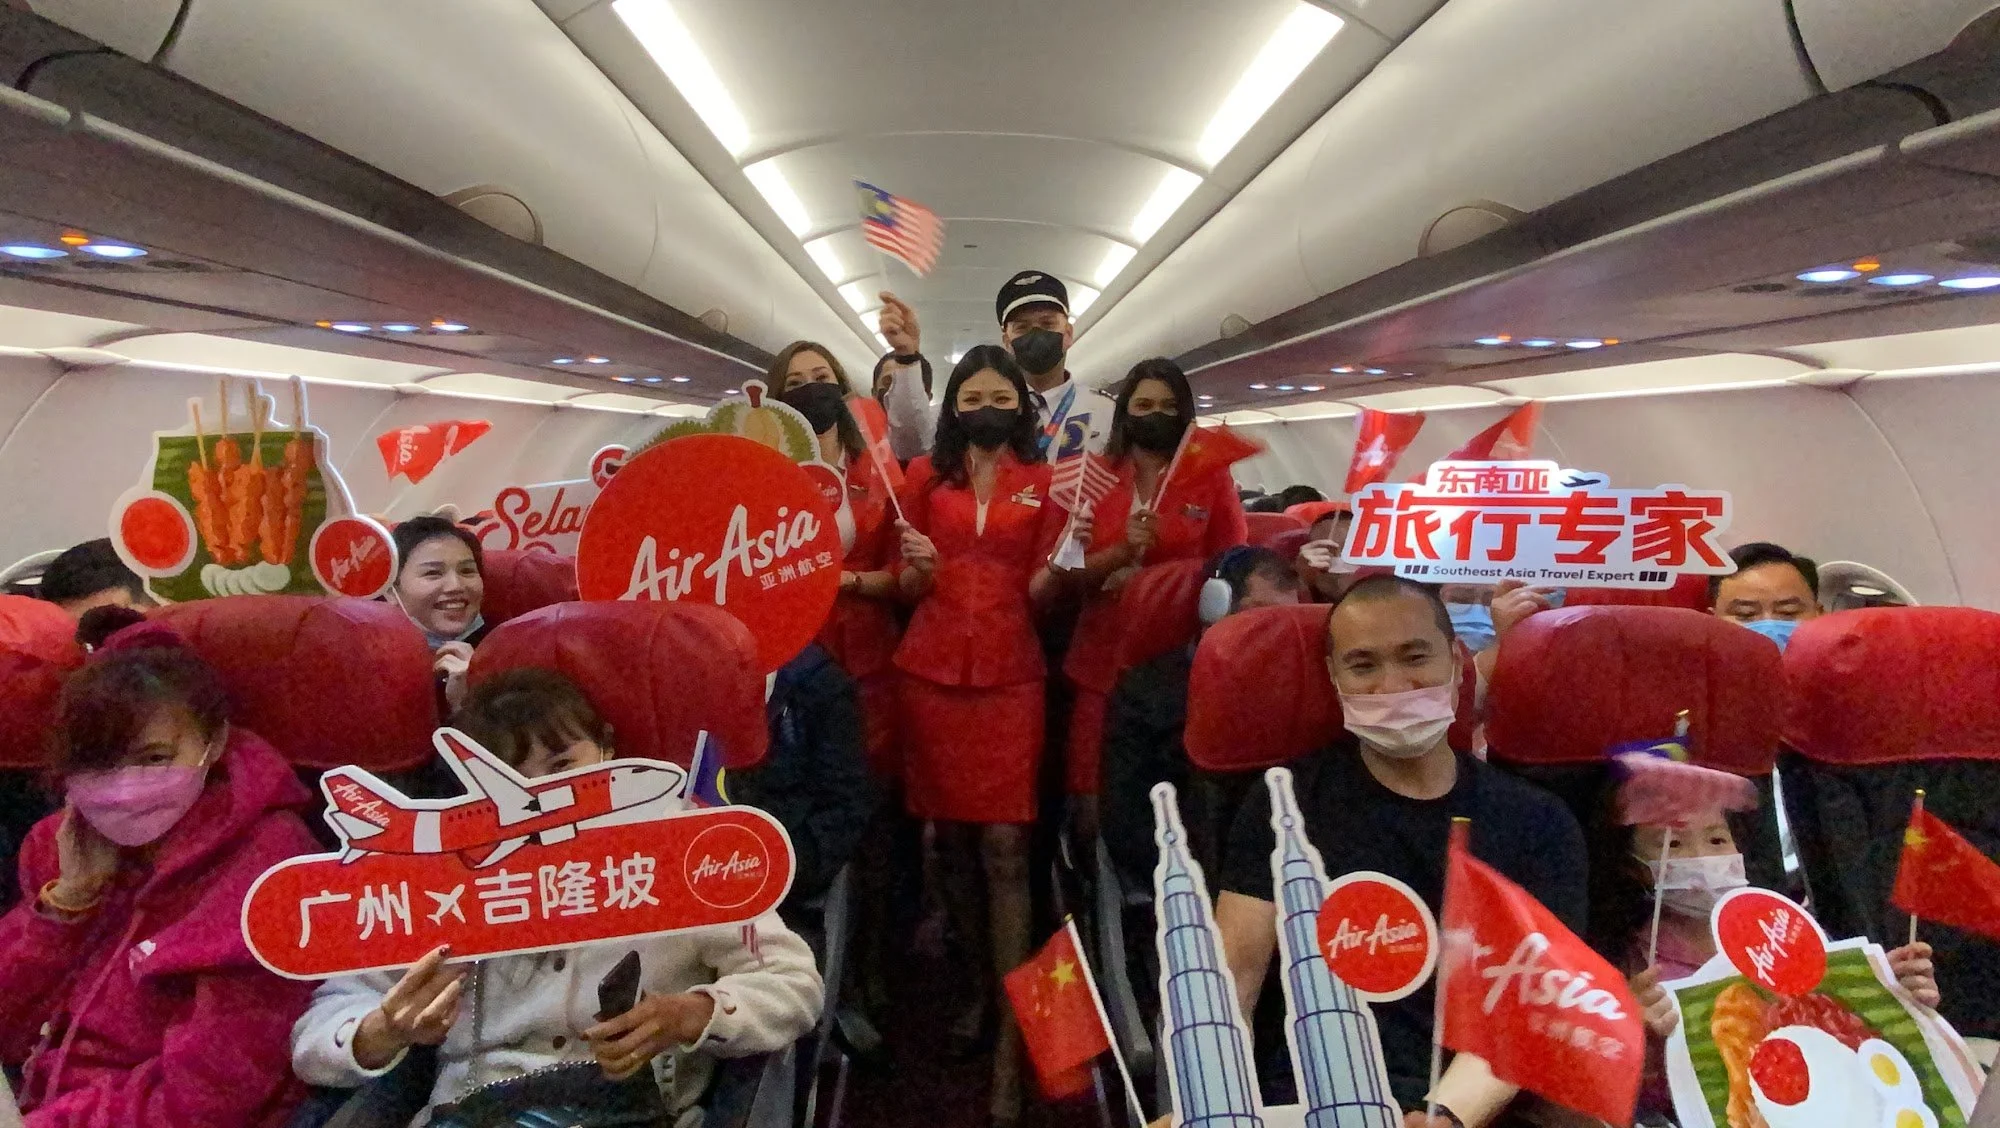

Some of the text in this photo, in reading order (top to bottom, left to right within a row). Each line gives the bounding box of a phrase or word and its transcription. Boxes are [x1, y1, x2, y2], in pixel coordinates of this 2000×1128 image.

[1437, 465, 1550, 495] 东南亚
[475, 487, 592, 552] Sela
[1349, 489, 1727, 567] 旅行专家
[760, 551, 834, 590] 亚洲航空
[1432, 565, 1635, 583] Southeast Asia Travel Expert
[299, 851, 660, 949] 广州 吉隆坡
